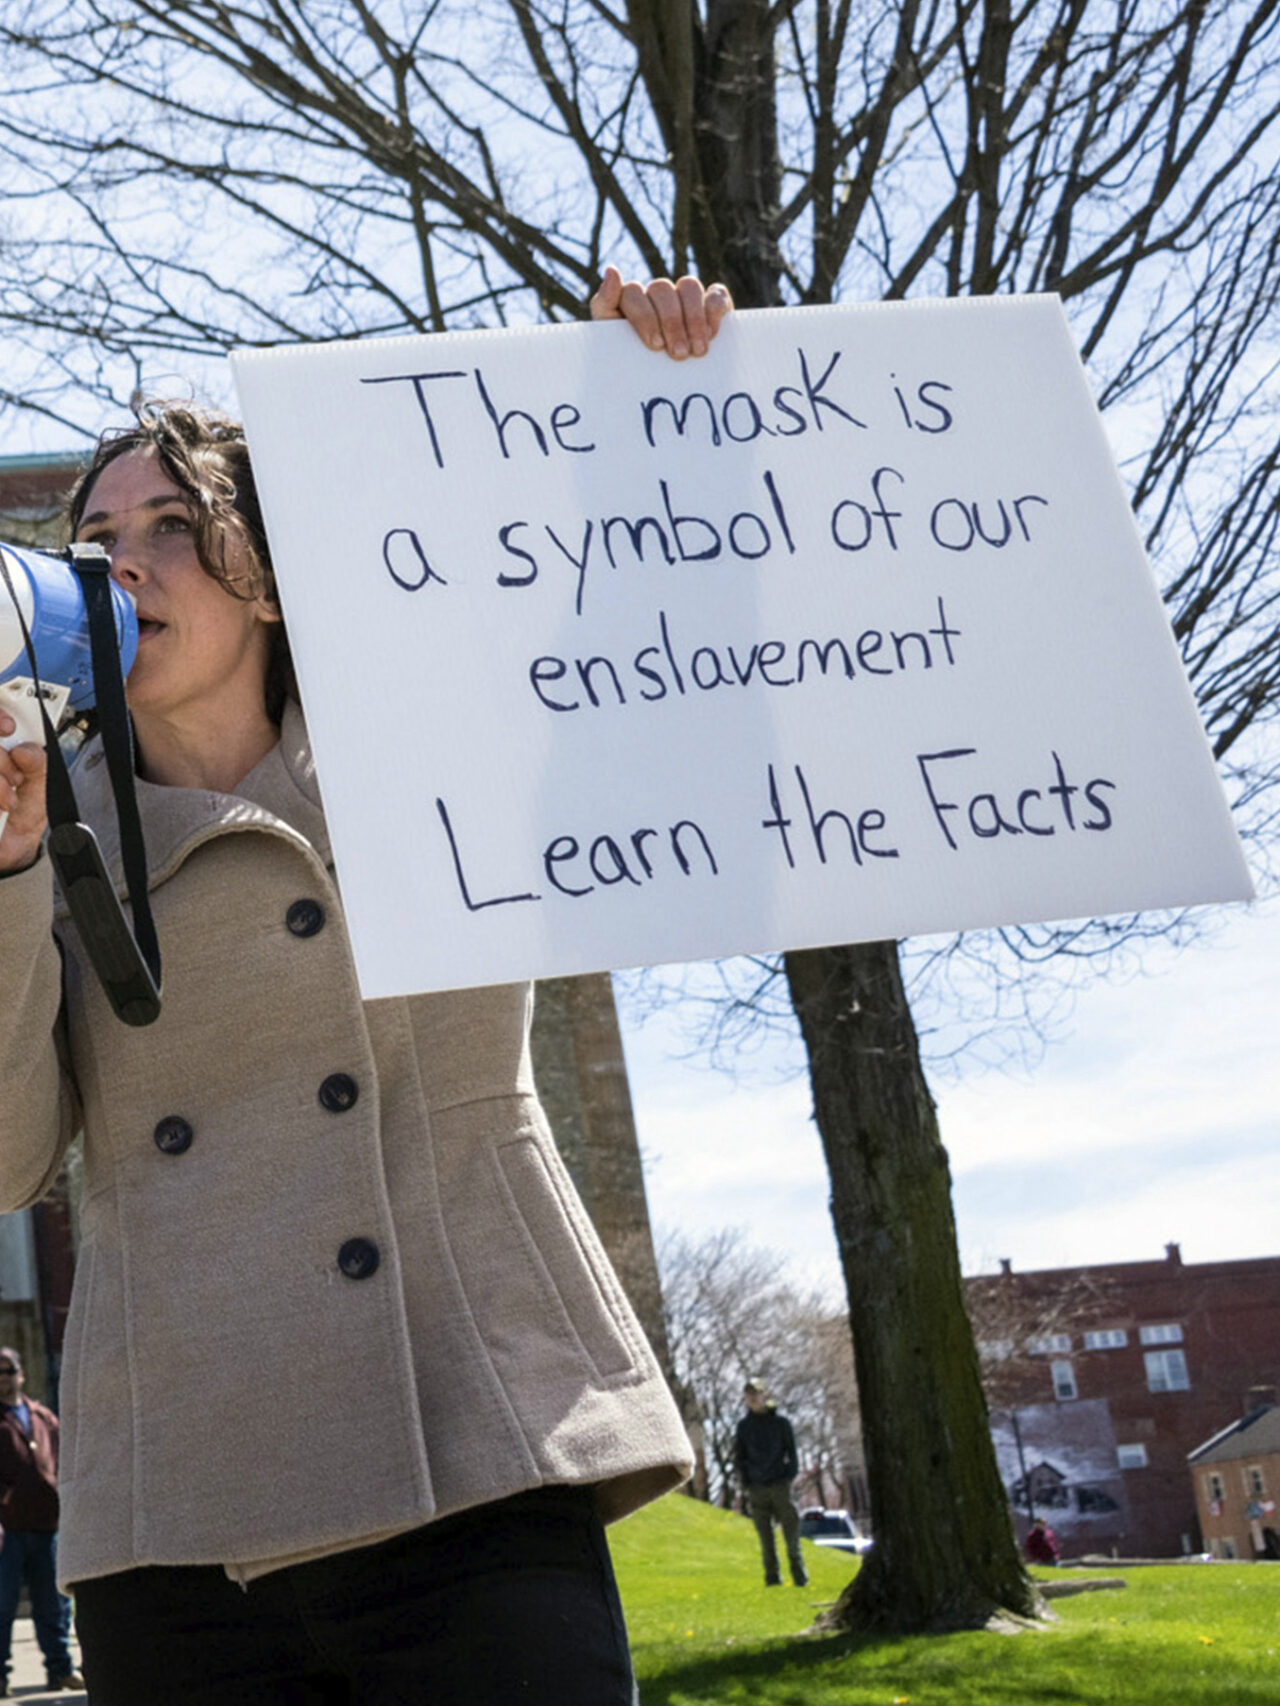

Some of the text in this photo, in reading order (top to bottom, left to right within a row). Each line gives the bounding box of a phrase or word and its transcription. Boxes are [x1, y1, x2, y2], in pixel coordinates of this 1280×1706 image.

[360, 368, 597, 470] The
[889, 372, 953, 434] is
[382, 466, 1049, 616] a symbol of our
[528, 596, 962, 713] enslavement
[436, 748, 1117, 912] Learn the Facts
